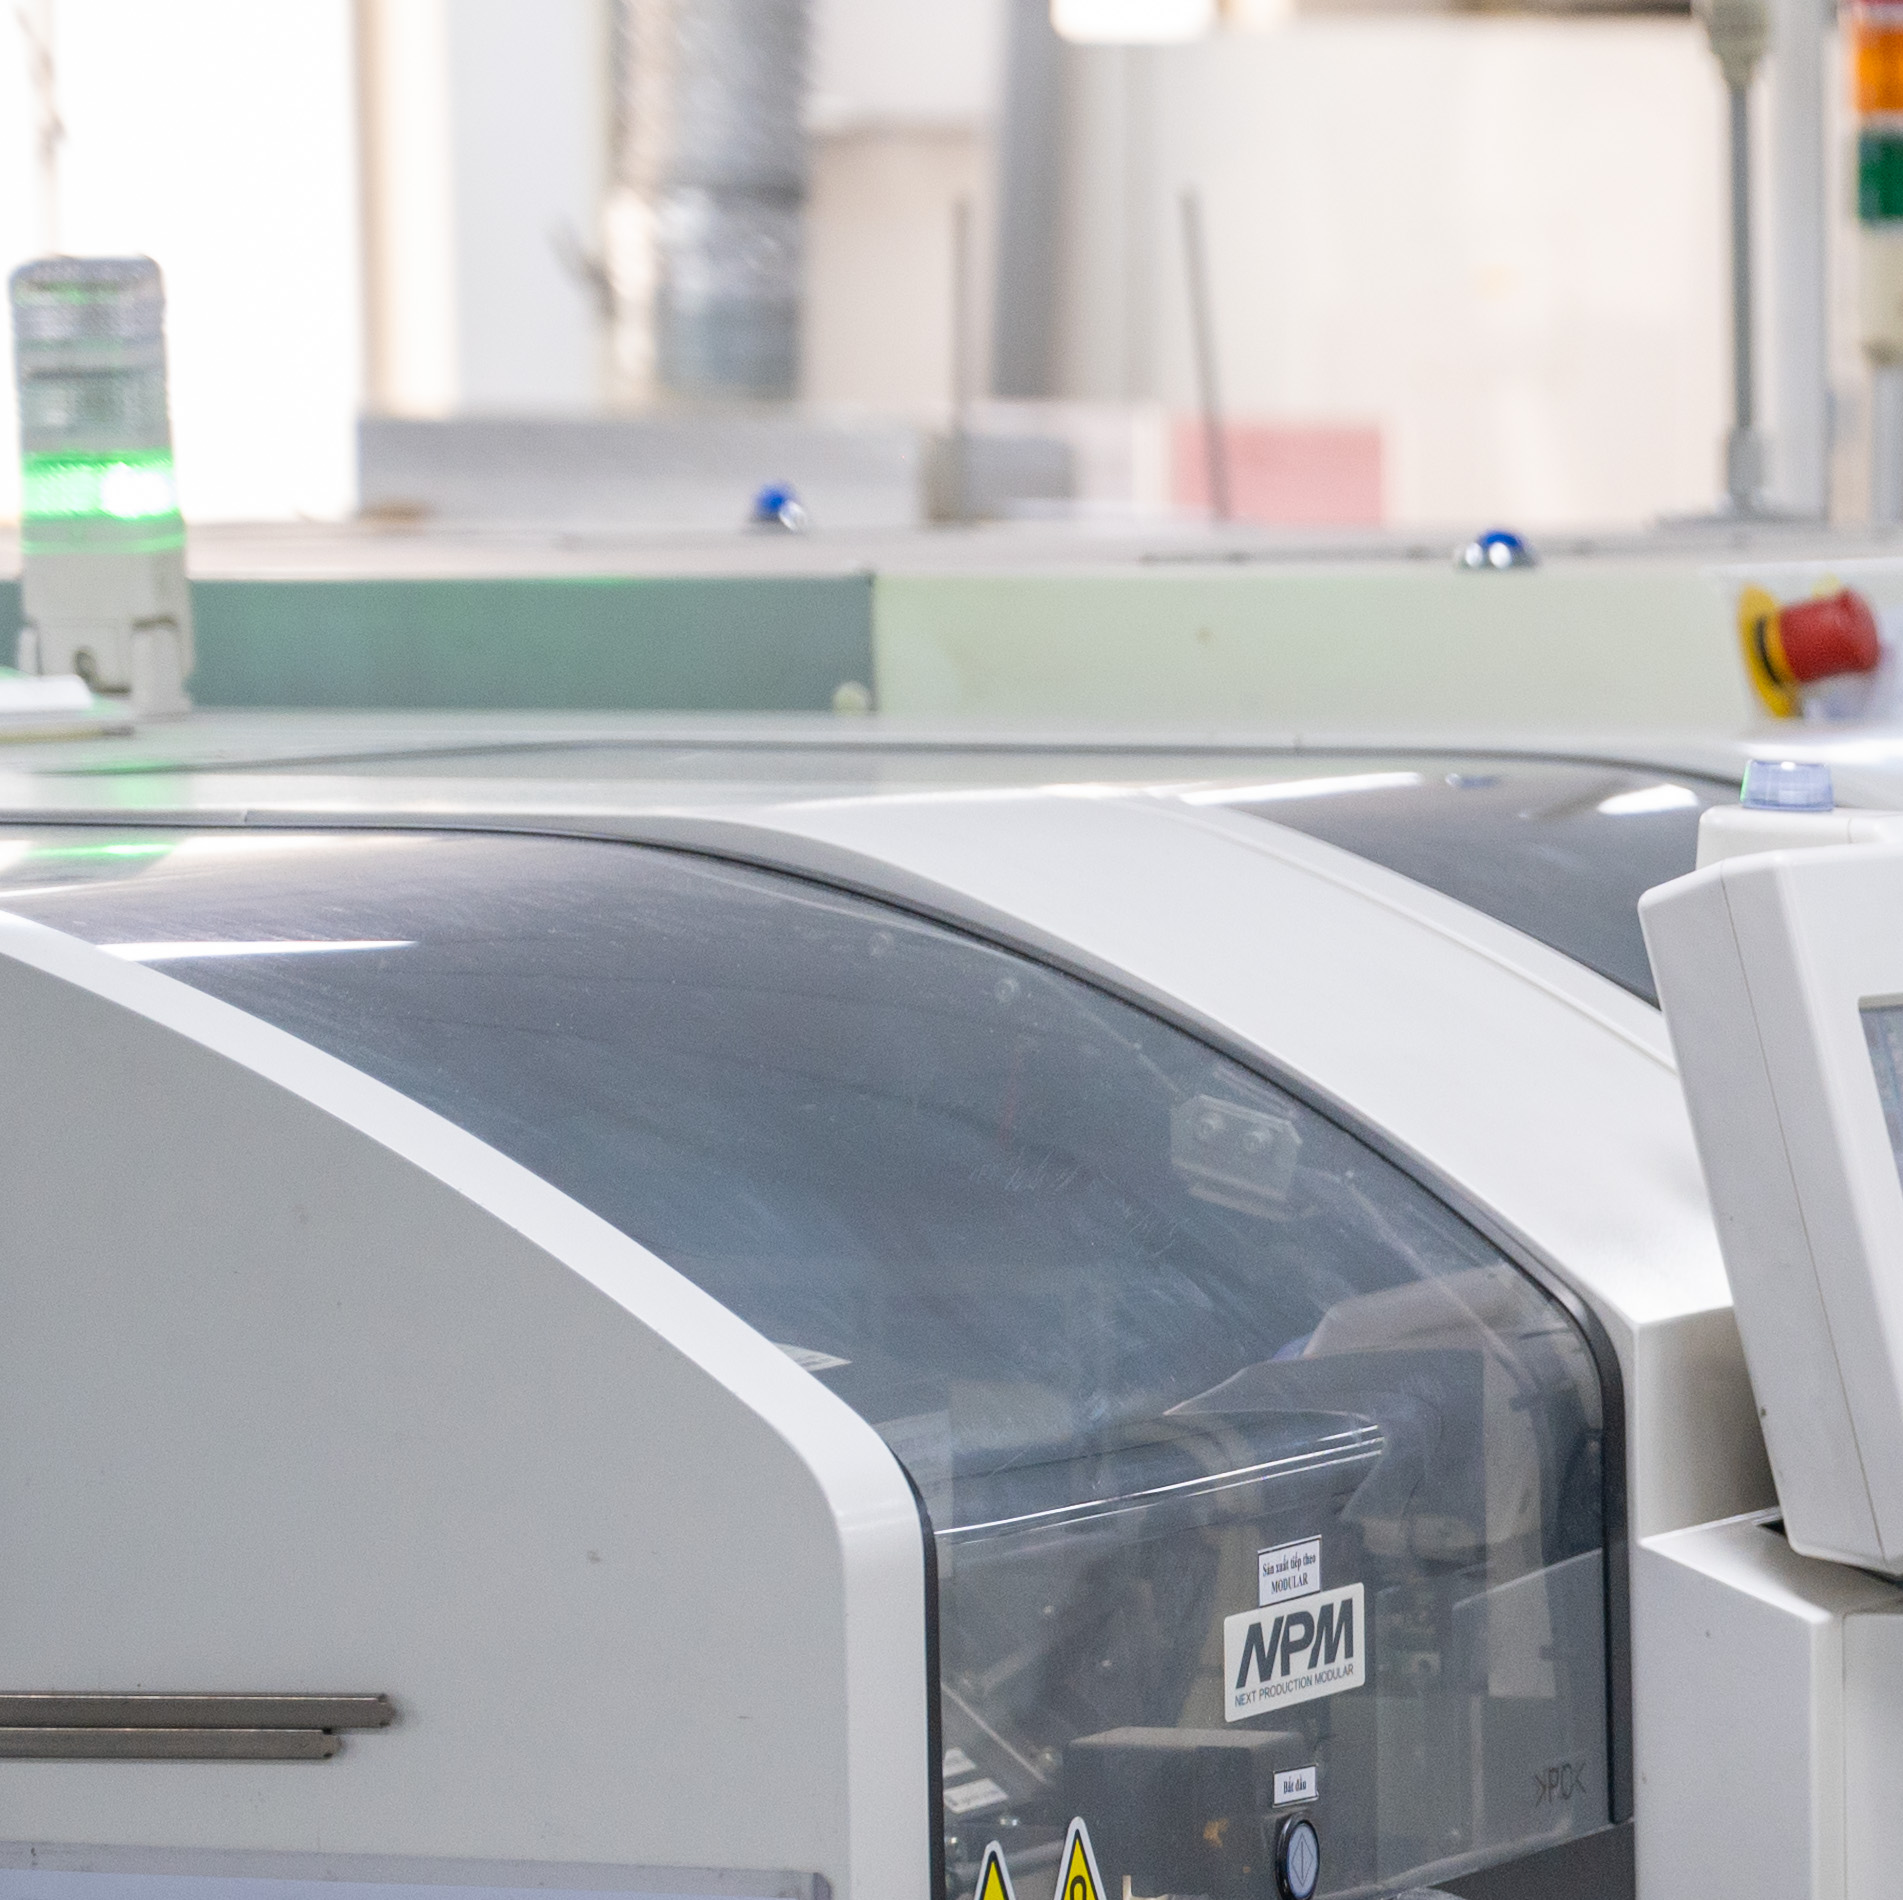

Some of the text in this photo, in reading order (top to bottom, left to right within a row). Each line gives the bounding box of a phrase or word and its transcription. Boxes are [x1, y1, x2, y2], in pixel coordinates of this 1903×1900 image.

[1302, 1553, 1316, 1567] theo
[1271, 1574, 1308, 1594] MODULAR
[1235, 1598, 1354, 1689] NPM
[1234, 1663, 1354, 1708] NEXT PRODUCTION MODULAR
